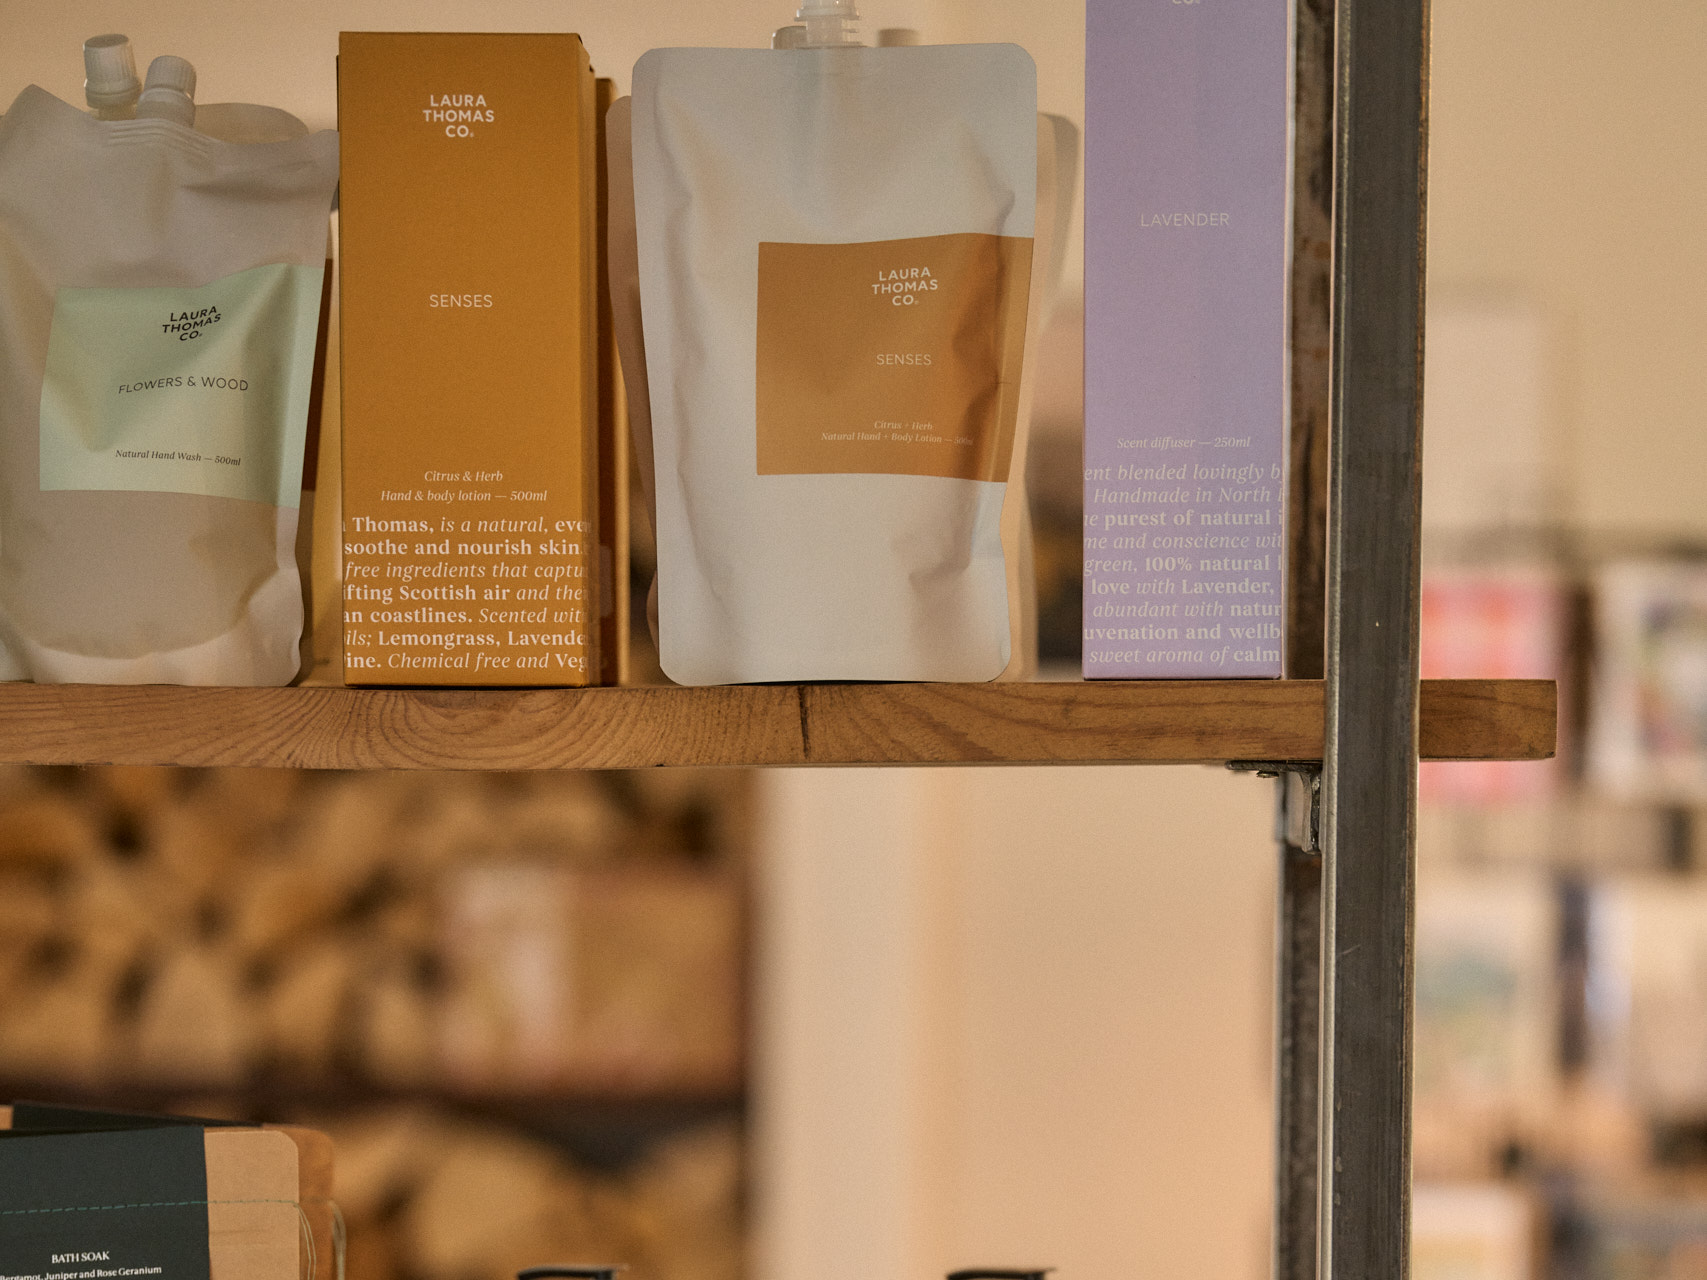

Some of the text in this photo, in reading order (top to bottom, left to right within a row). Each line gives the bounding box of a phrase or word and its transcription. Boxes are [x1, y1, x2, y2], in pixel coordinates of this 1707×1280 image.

[430, 94, 487, 107] LAURA
[422, 110, 494, 122] THOMAS
[1140, 213, 1230, 227] LAVENDER
[879, 267, 931, 281] LAURA
[871, 279, 938, 295] THOMAS
[429, 294, 493, 308] SENSES
[170, 306, 217, 322] LAURA
[162, 313, 221, 333] THOMAS
[876, 354, 932, 366] SENSES
[118, 376, 248, 394] FLOWERS & WOOD
[874, 421, 933, 430] Citrus Herb
[821, 432, 855, 441] Natural
[857, 433, 880, 441] Hand
[891, 433, 912, 443] Body
[915, 434, 942, 443] Lotion
[1117, 436, 1251, 449] Scent diffuser 250ml
[115, 450, 241, 466] Natural Hand Wash 500ml
[424, 471, 503, 482] Citrus & Herb
[1117, 464, 1187, 481] blended
[1193, 463, 1264, 484] lovingly
[381, 490, 547, 504] Hand & body lotion 500ml
[1094, 487, 1190, 503] Handmade
[1196, 487, 1212, 502] in
[1219, 487, 1270, 502] North
[352, 516, 434, 534] Thomas,
[441, 517, 455, 532] is
[461, 520, 471, 532] a
[477, 517, 548, 534] natural,
[555, 520, 590, 532] eve
[1105, 509, 1271, 530] purest of natural
[344, 539, 408, 555] soothe
[414, 539, 450, 555] and
[458, 539, 532, 555] nourish
[1113, 533, 1146, 549] and
[1152, 533, 1249, 549] conscience
[345, 561, 586, 582] free ingredients that captu
[1084, 559, 1137, 577] green,
[1145, 557, 1192, 572] 100%
[1200, 555, 1270, 571] natural
[399, 584, 476, 600] Scottish
[483, 584, 510, 600] air
[516, 584, 549, 600] and
[1091, 578, 1274, 597] love with Lavender,
[370, 607, 473, 623] coastlines.
[479, 607, 547, 623] Scented
[1093, 602, 1178, 618] abundant
[1184, 602, 1223, 617] with
[344, 630, 372, 648] ils;
[378, 630, 500, 650] Lemongrass,
[1186, 624, 1221, 640] and
[344, 653, 381, 668] ine.
[388, 653, 470, 668] Chemical
[475, 652, 511, 672] free
[516, 653, 549, 668] and
[1089, 646, 1280, 667] sweet aroma of calm
[51, 1251, 110, 1264] BATH SOAK
[79, 1269, 96, 1279] and
[97, 1269, 117, 1278] Rose
[118, 1266, 162, 1276] Geranium
